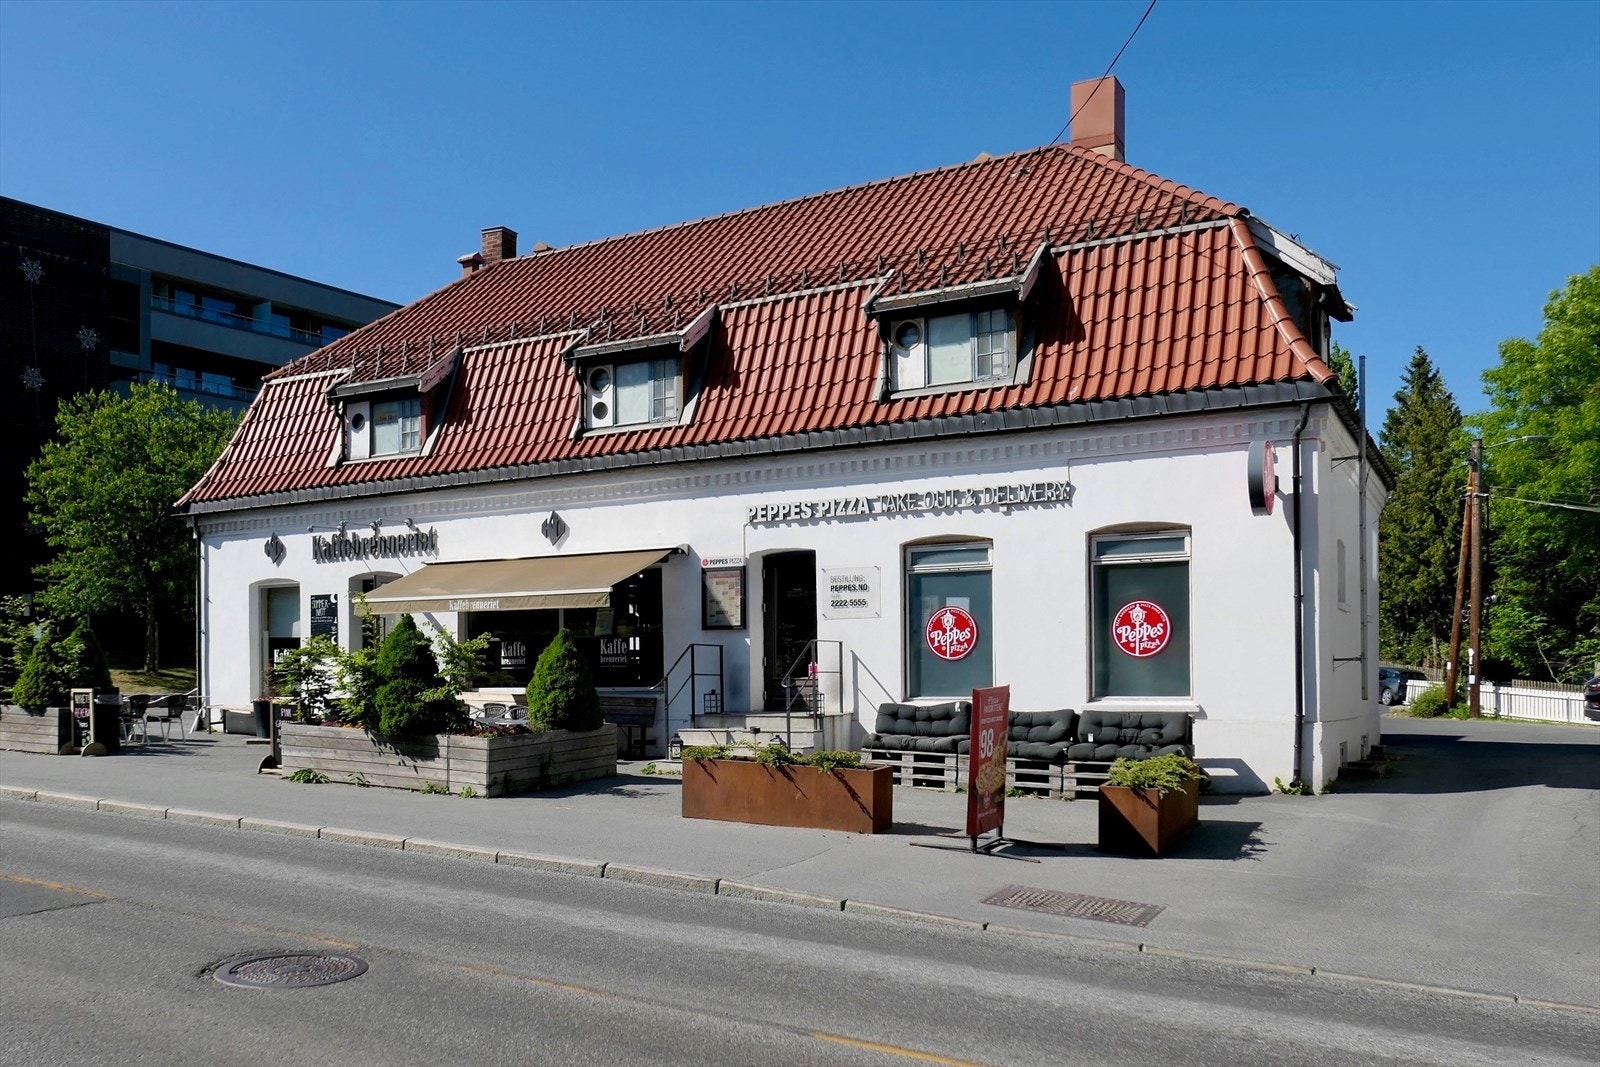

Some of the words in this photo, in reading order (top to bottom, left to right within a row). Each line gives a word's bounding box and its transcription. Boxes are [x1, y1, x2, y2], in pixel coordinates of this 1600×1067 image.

[747, 502, 812, 522] PEPPES
[817, 497, 871, 517] PIZZA
[877, 493, 920, 513] TAKE
[923, 490, 955, 508] OUT
[965, 488, 978, 506] &
[312, 526, 436, 562] Kaffebrenneriet
[830, 583, 869, 592] PEPPES.NO
[449, 599, 500, 611] Kaffebrenneriet
[830, 599, 849, 607] 2222
[849, 598, 867, 607] 5555
[930, 627, 971, 647] Peppes
[1116, 622, 1164, 644] Peppes
[501, 641, 526, 657] Kaffe
[600, 638, 628, 655] Kaffe
[980, 728, 995, 759] 98
